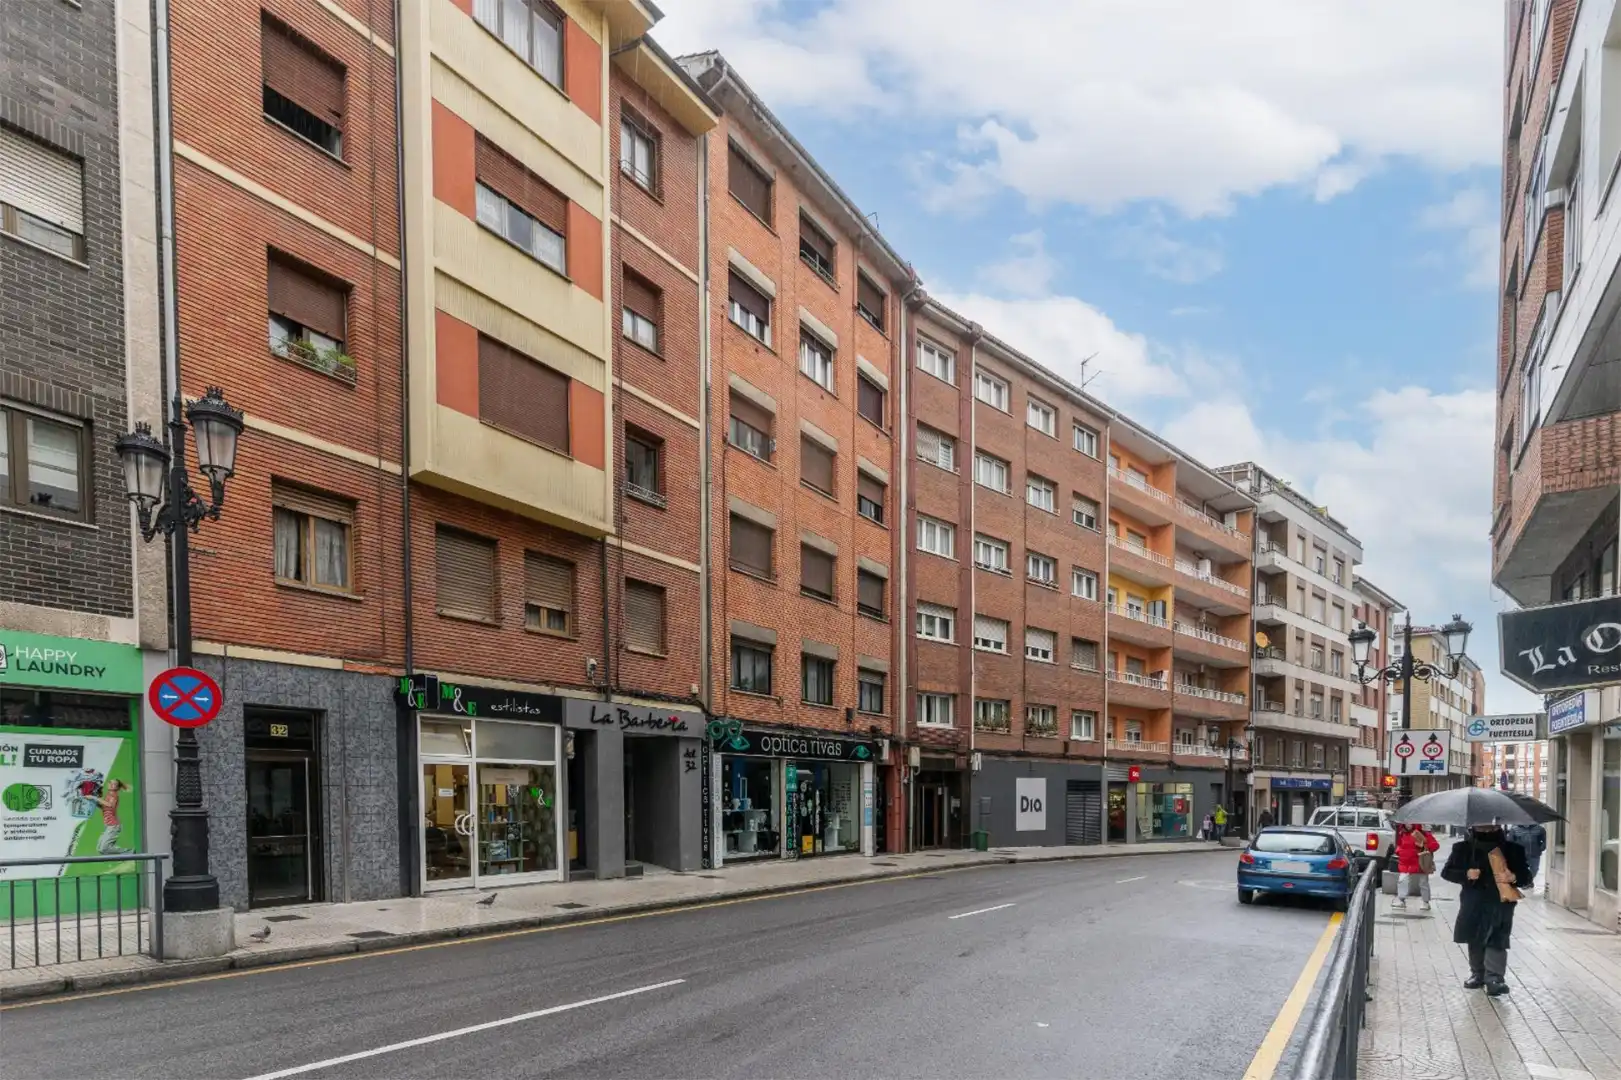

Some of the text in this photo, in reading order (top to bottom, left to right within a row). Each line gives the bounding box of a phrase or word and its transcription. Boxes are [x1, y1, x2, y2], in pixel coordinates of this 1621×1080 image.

[15, 645, 77, 663] HAPPY
[1518, 645, 1578, 676] La
[16, 658, 106, 679] LAUNDRY
[490, 697, 541, 715] estilistas
[590, 705, 614, 724] La
[1490, 717, 1534, 726] ORTOPEDIA
[271, 724, 288, 736] 32
[1489, 729, 1534, 738] FUENTESILA
[28, 748, 79, 756] CUIDAMOS
[761, 733, 842, 757] optica rivas
[29, 755, 78, 764] TU ROPA
[684, 760, 698, 772] 32
